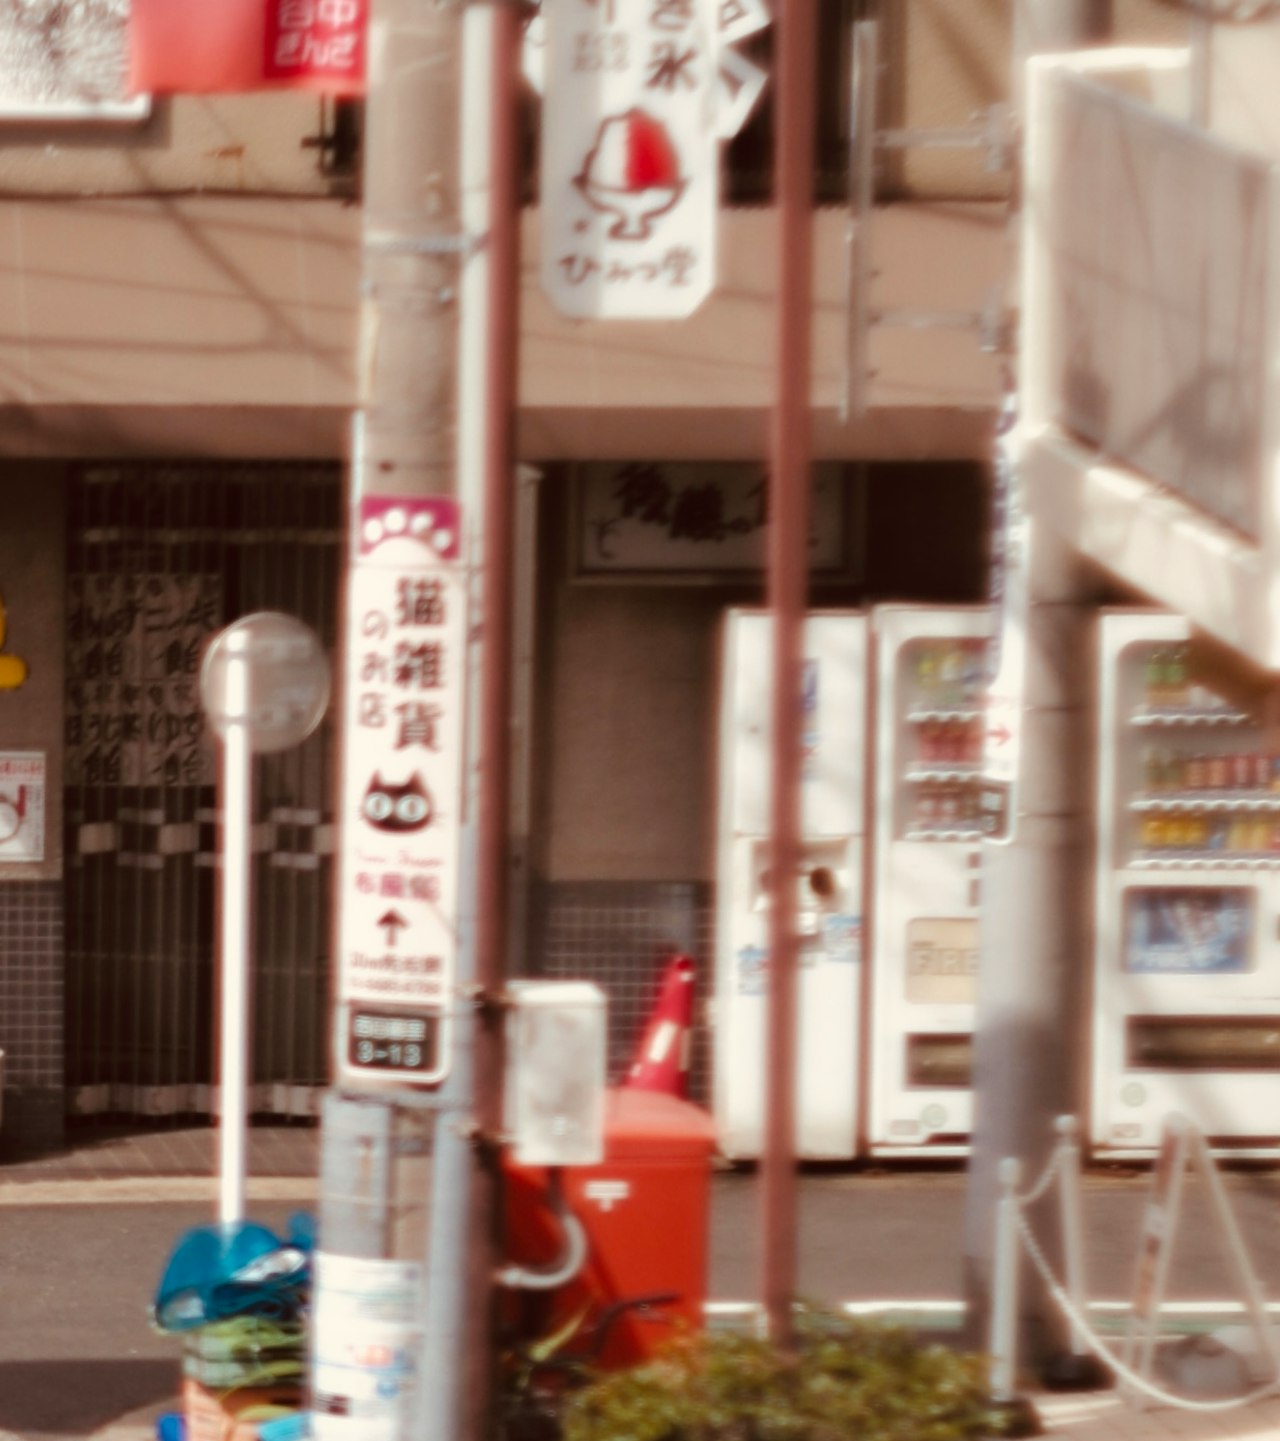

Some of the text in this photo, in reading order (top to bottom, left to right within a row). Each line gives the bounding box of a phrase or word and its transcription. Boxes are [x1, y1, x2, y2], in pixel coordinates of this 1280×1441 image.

[558, 247, 697, 287] ひみつ堂
[357, 607, 387, 730] のお店
[394, 577, 445, 753] 猫雑貨
[357, 1041, 421, 1067] 3-13
